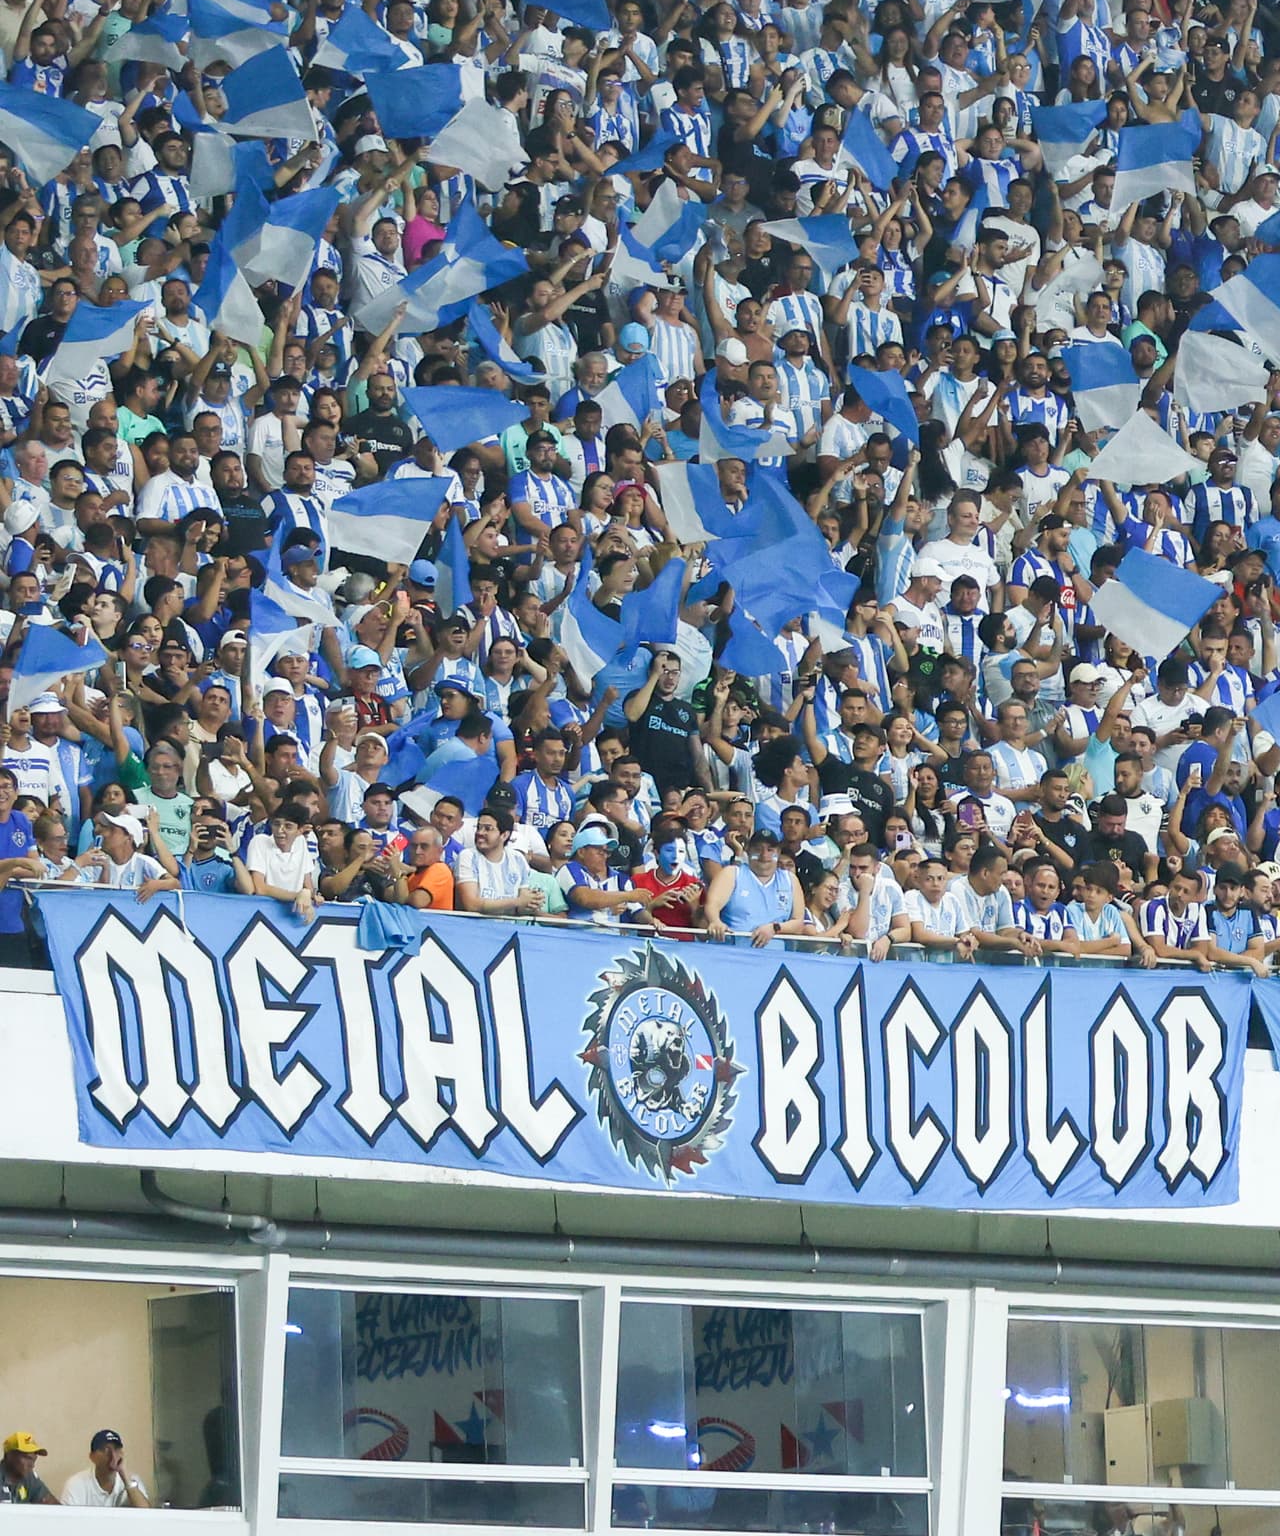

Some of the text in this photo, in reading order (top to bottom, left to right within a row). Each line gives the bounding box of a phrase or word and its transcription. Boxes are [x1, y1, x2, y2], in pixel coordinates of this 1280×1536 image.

[74, 903, 1229, 1198] METAL BICOLOR
[617, 992, 697, 1040] METAL
